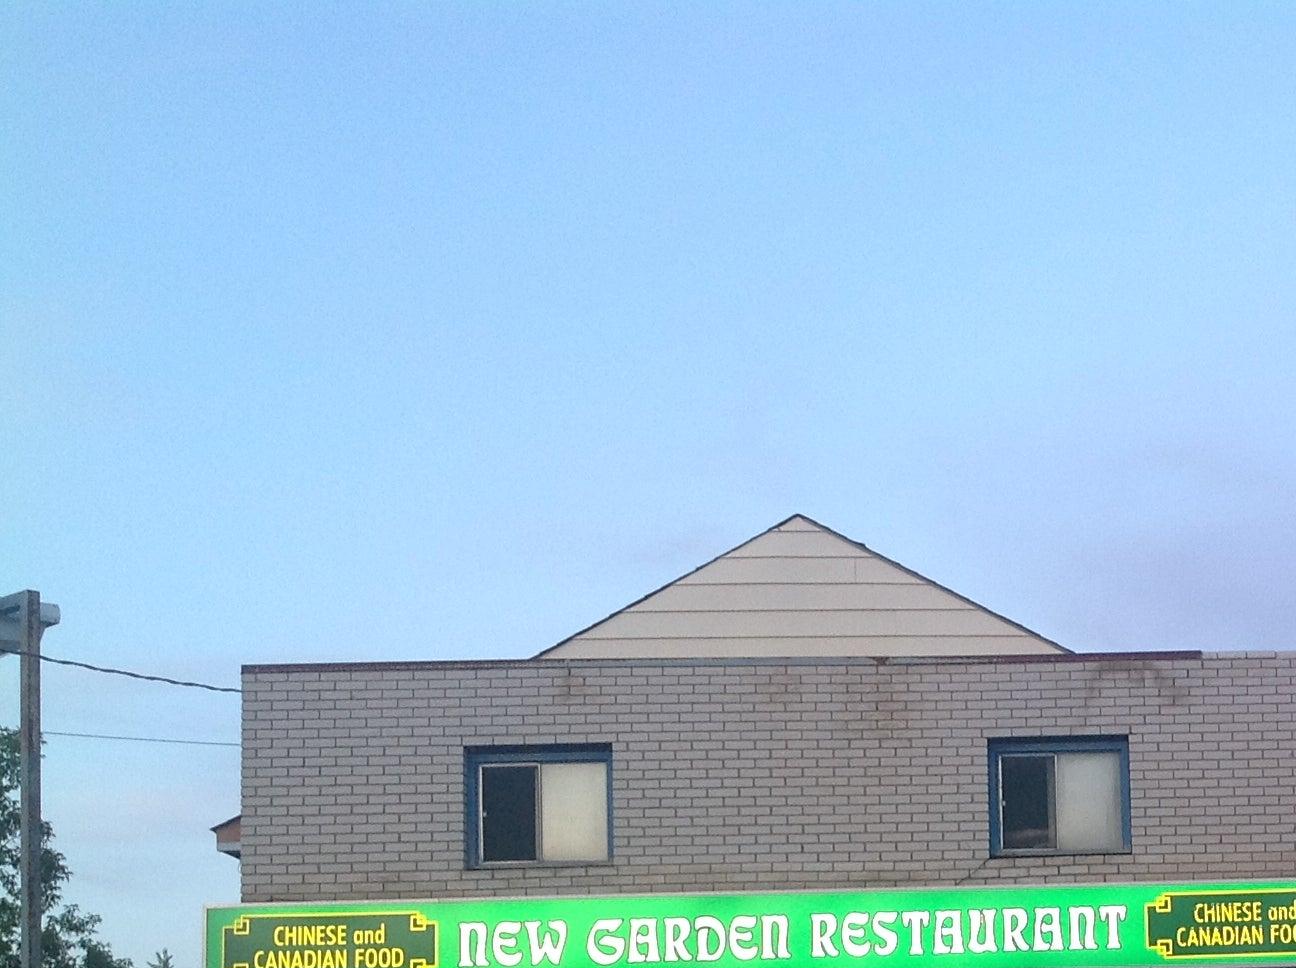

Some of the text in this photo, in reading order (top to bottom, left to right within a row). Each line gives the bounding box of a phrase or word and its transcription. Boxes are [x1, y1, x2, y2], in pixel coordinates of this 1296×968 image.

[1193, 901, 1262, 923] CHINESE
[274, 922, 385, 946] CHINESE and
[457, 904, 1126, 968] NEW GARDEN RESTAURANT
[1176, 925, 1264, 947] CANADIAN
[354, 947, 405, 968] FOOD
